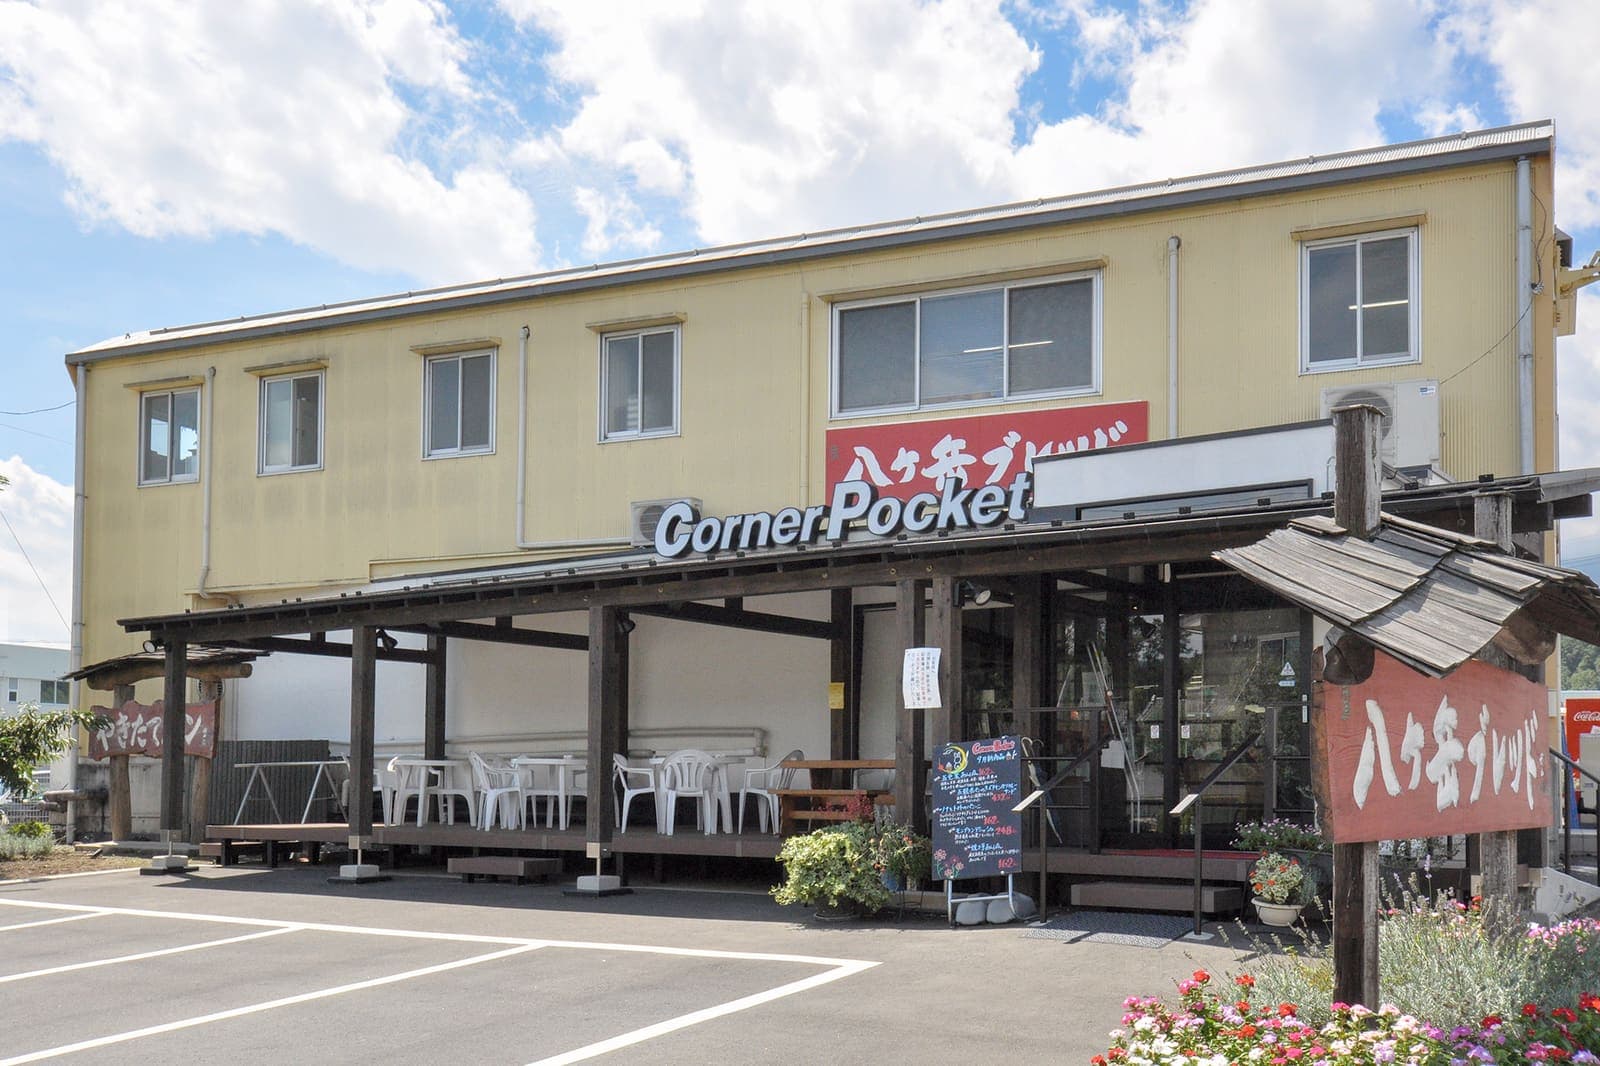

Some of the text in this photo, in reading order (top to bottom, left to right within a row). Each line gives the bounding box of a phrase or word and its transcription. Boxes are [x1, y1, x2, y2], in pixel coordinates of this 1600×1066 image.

[96, 711, 202, 752] やきたてン
